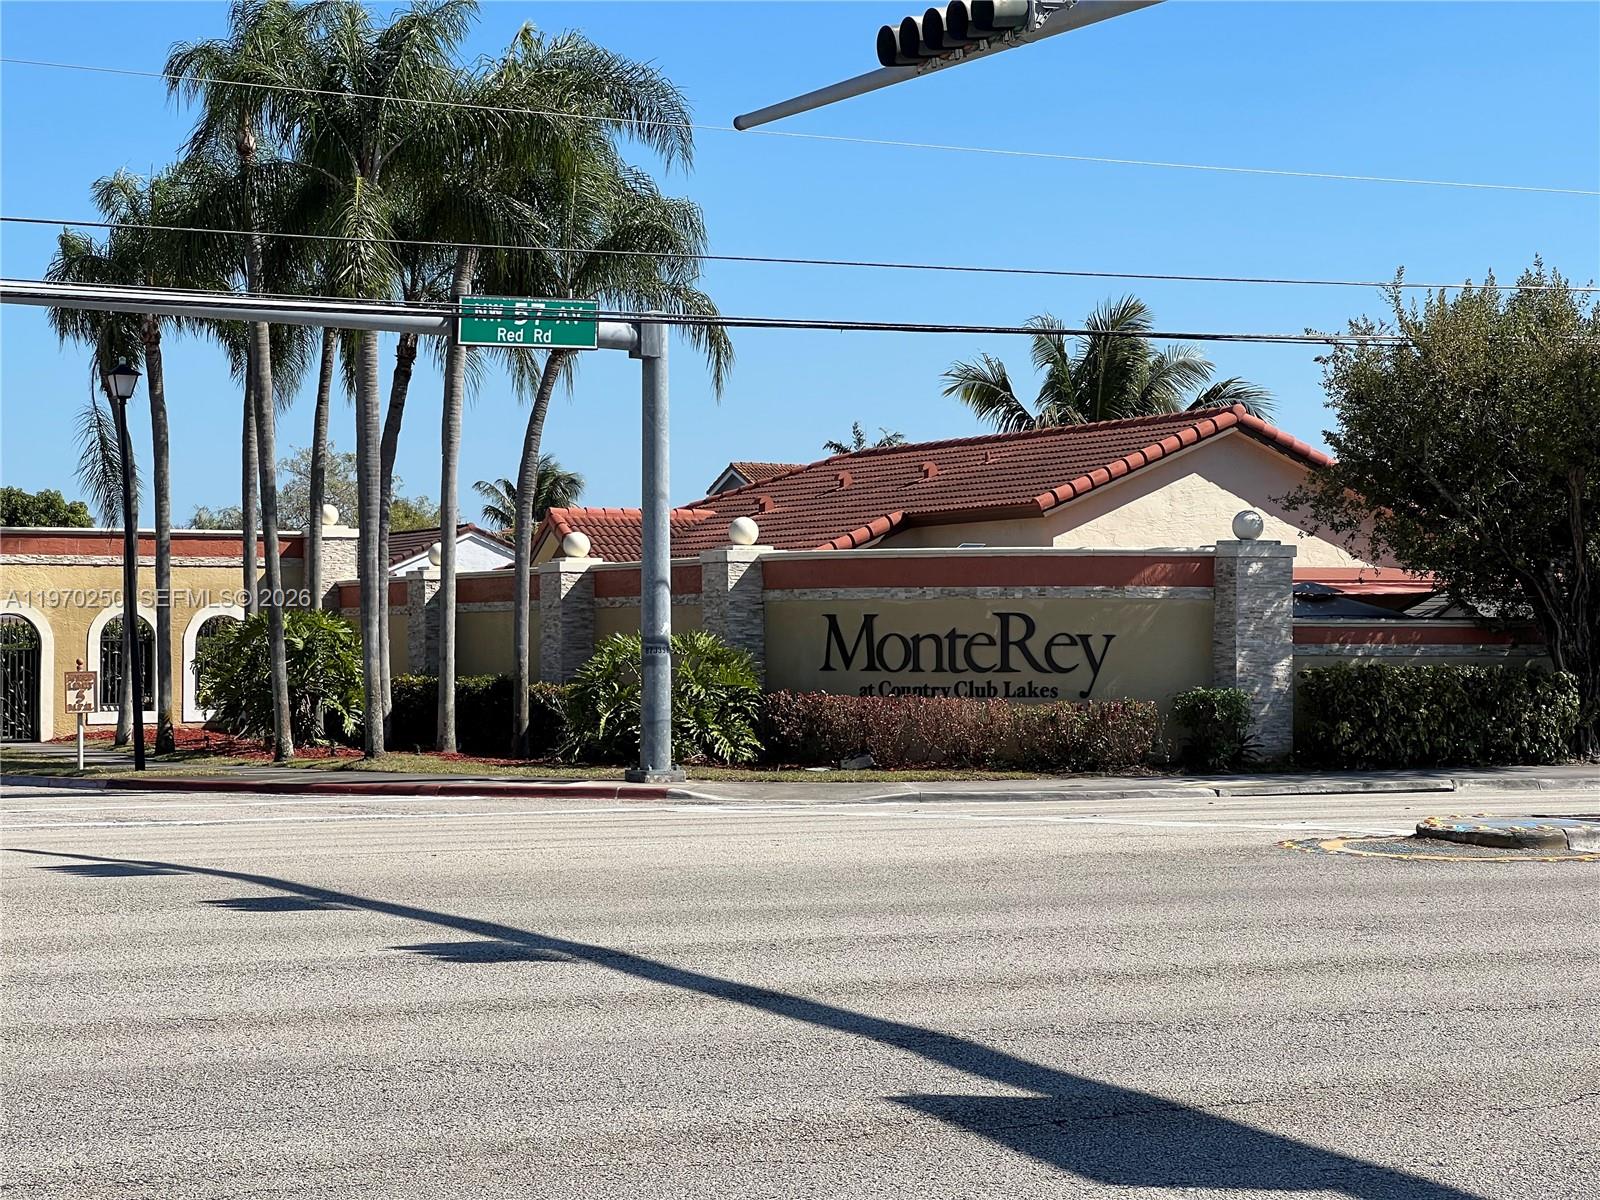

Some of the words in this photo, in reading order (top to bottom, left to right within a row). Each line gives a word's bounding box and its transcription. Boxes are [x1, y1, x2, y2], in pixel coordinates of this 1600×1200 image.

[514, 302, 546, 326] 57
[497, 327, 524, 342] Red
[533, 328, 552, 343] Rd
[819, 612, 1117, 699] MonteRey
[859, 684, 875, 697] at
[878, 680, 951, 698] Country
[953, 680, 998, 698] Club
[1003, 680, 1059, 698] Lakes
